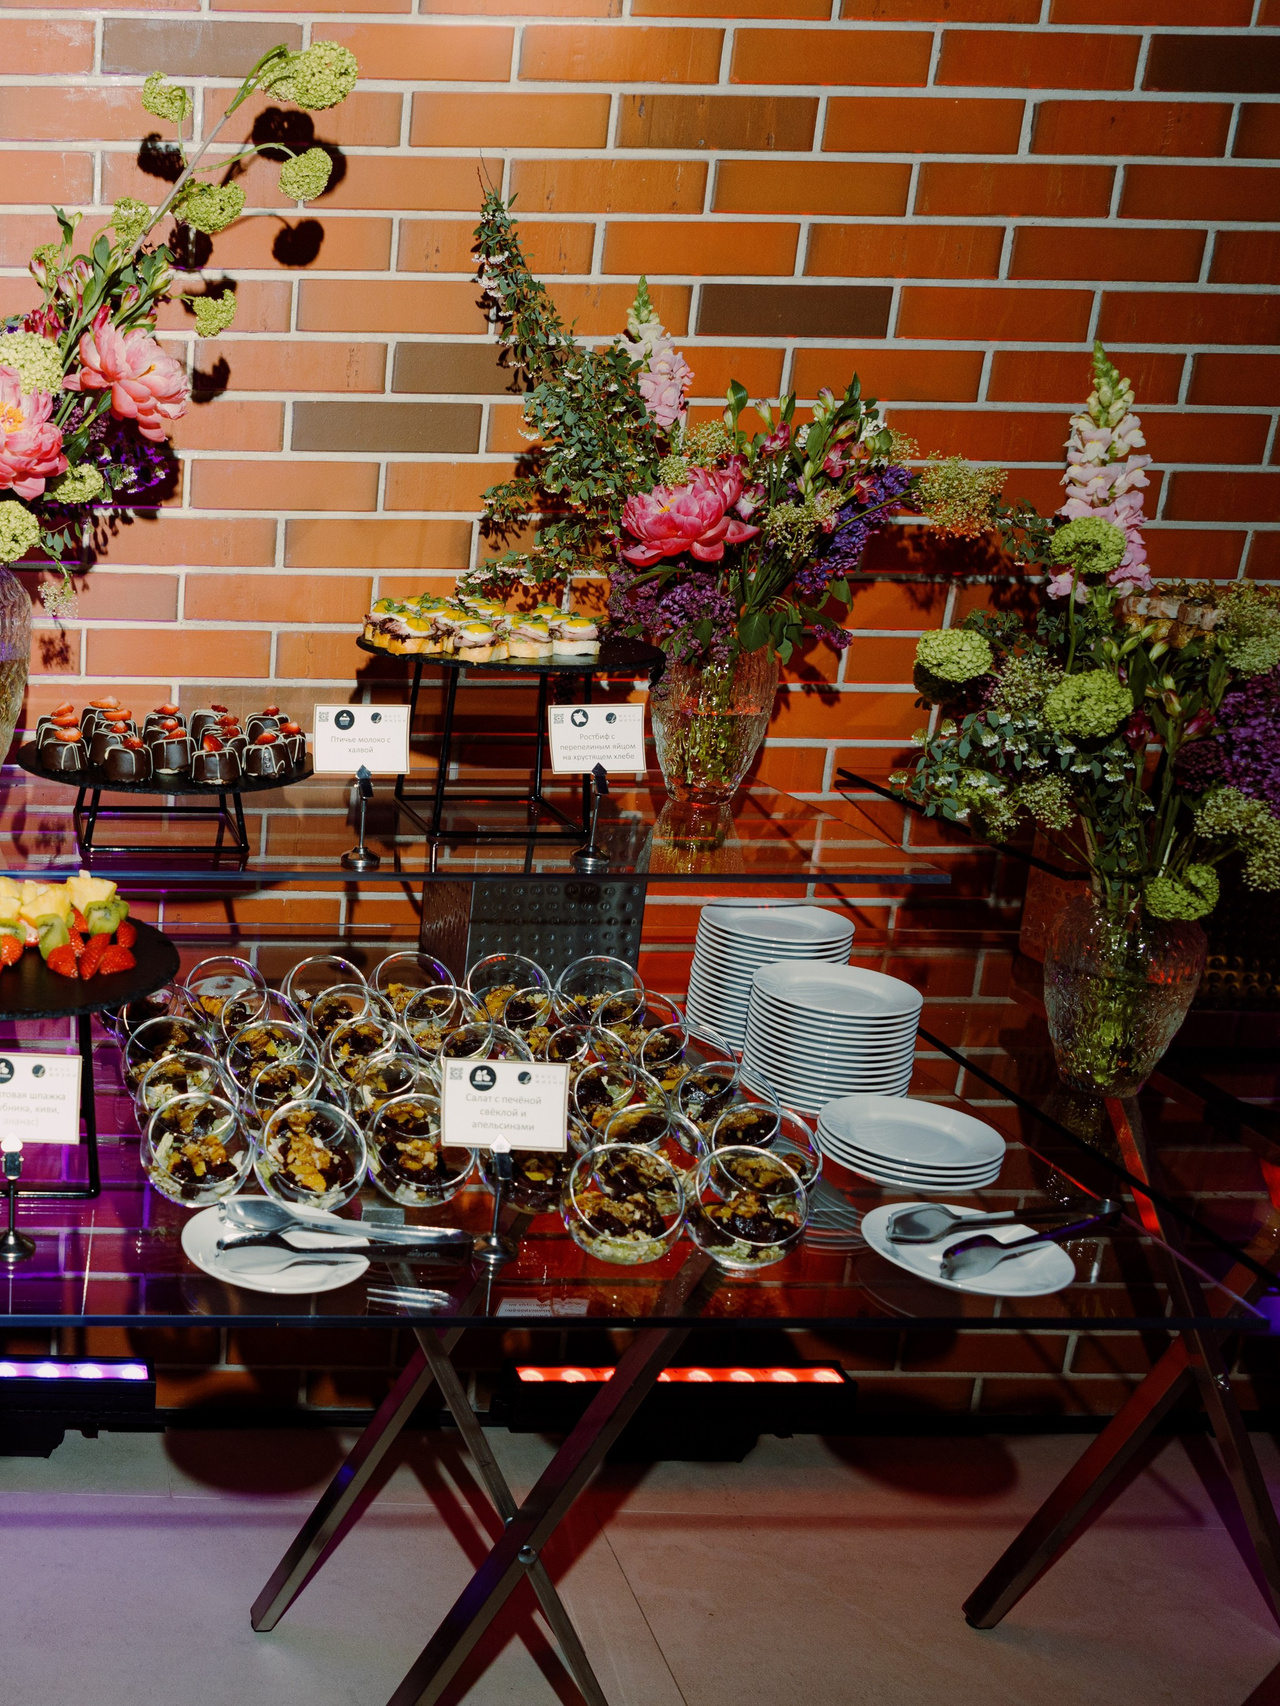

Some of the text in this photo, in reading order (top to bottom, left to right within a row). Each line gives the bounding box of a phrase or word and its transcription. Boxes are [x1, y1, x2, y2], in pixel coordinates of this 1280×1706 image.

[579, 733, 610, 741] Ростбиф
[29, 1093, 66, 1101] шпажка
[465, 1093, 493, 1103] Салат
[501, 1095, 542, 1105] печёной
[35, 1106, 60, 1114] киви,
[480, 1107, 518, 1117] свёклой
[471, 1120, 535, 1131] апельсинами
